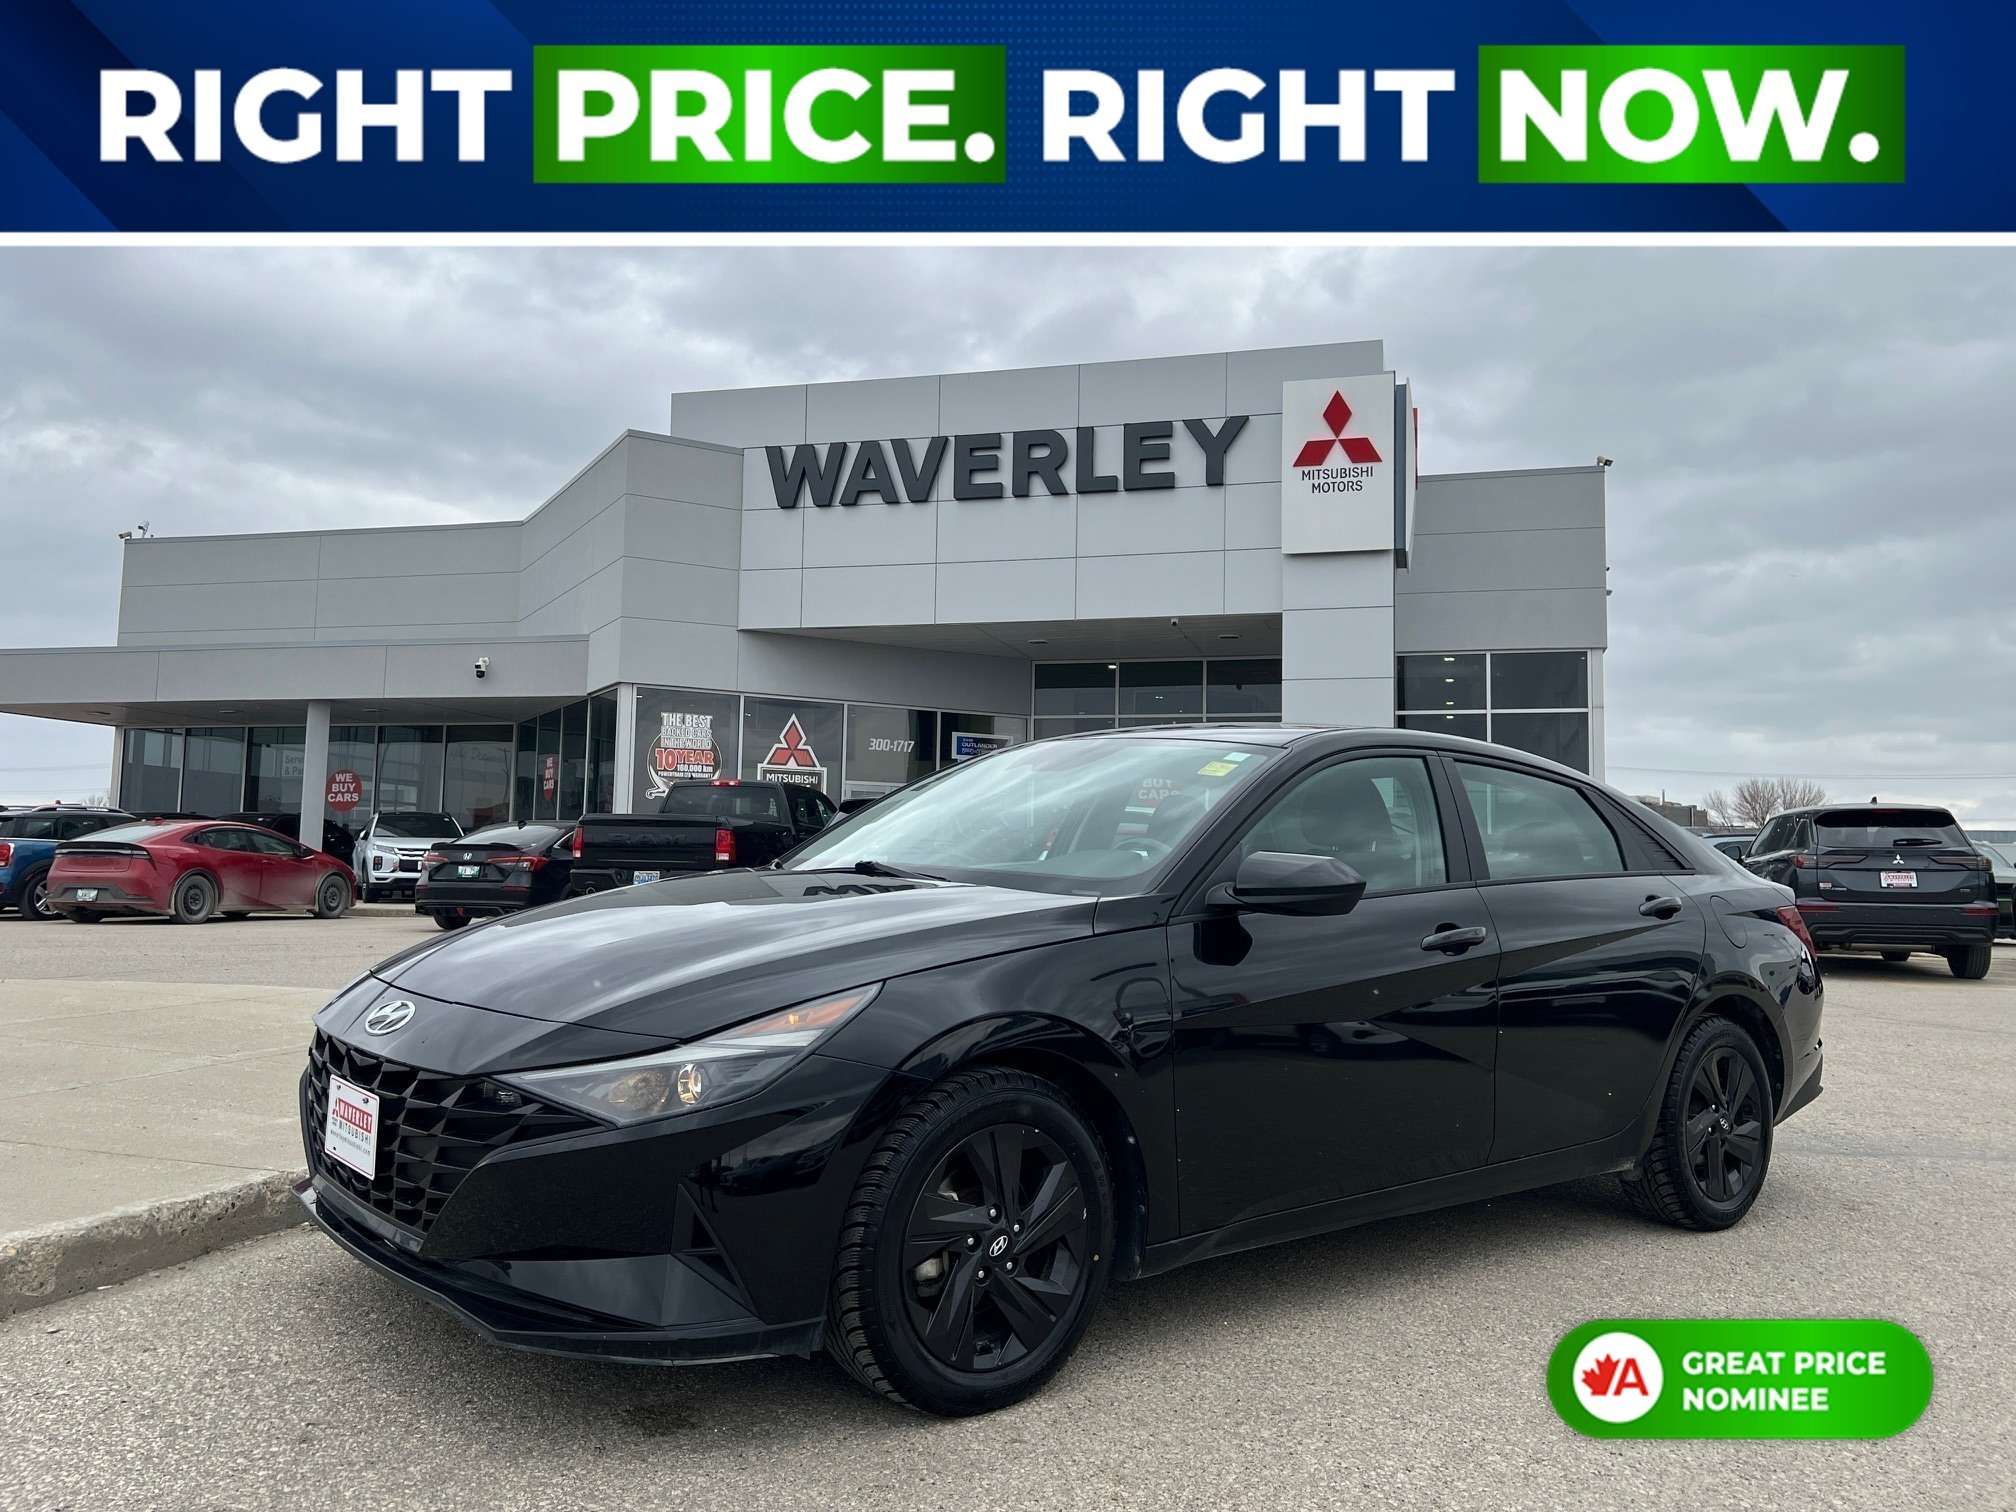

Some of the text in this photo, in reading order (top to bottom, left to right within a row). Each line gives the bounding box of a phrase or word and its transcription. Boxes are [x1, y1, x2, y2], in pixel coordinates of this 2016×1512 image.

[765, 415, 1249, 509] WAVERLEY
[1301, 466, 1374, 481] MITSUBISHI
[1311, 480, 1363, 494] MOTORS
[661, 712, 713, 728] THE BEST
[868, 738, 915, 753] 300-1717
[655, 748, 714, 770] 10 YEAR
[335, 773, 353, 782] WE
[766, 773, 819, 784] MITSUBISHI
[332, 783, 355, 792] BUY
[327, 793, 359, 802] CARS
